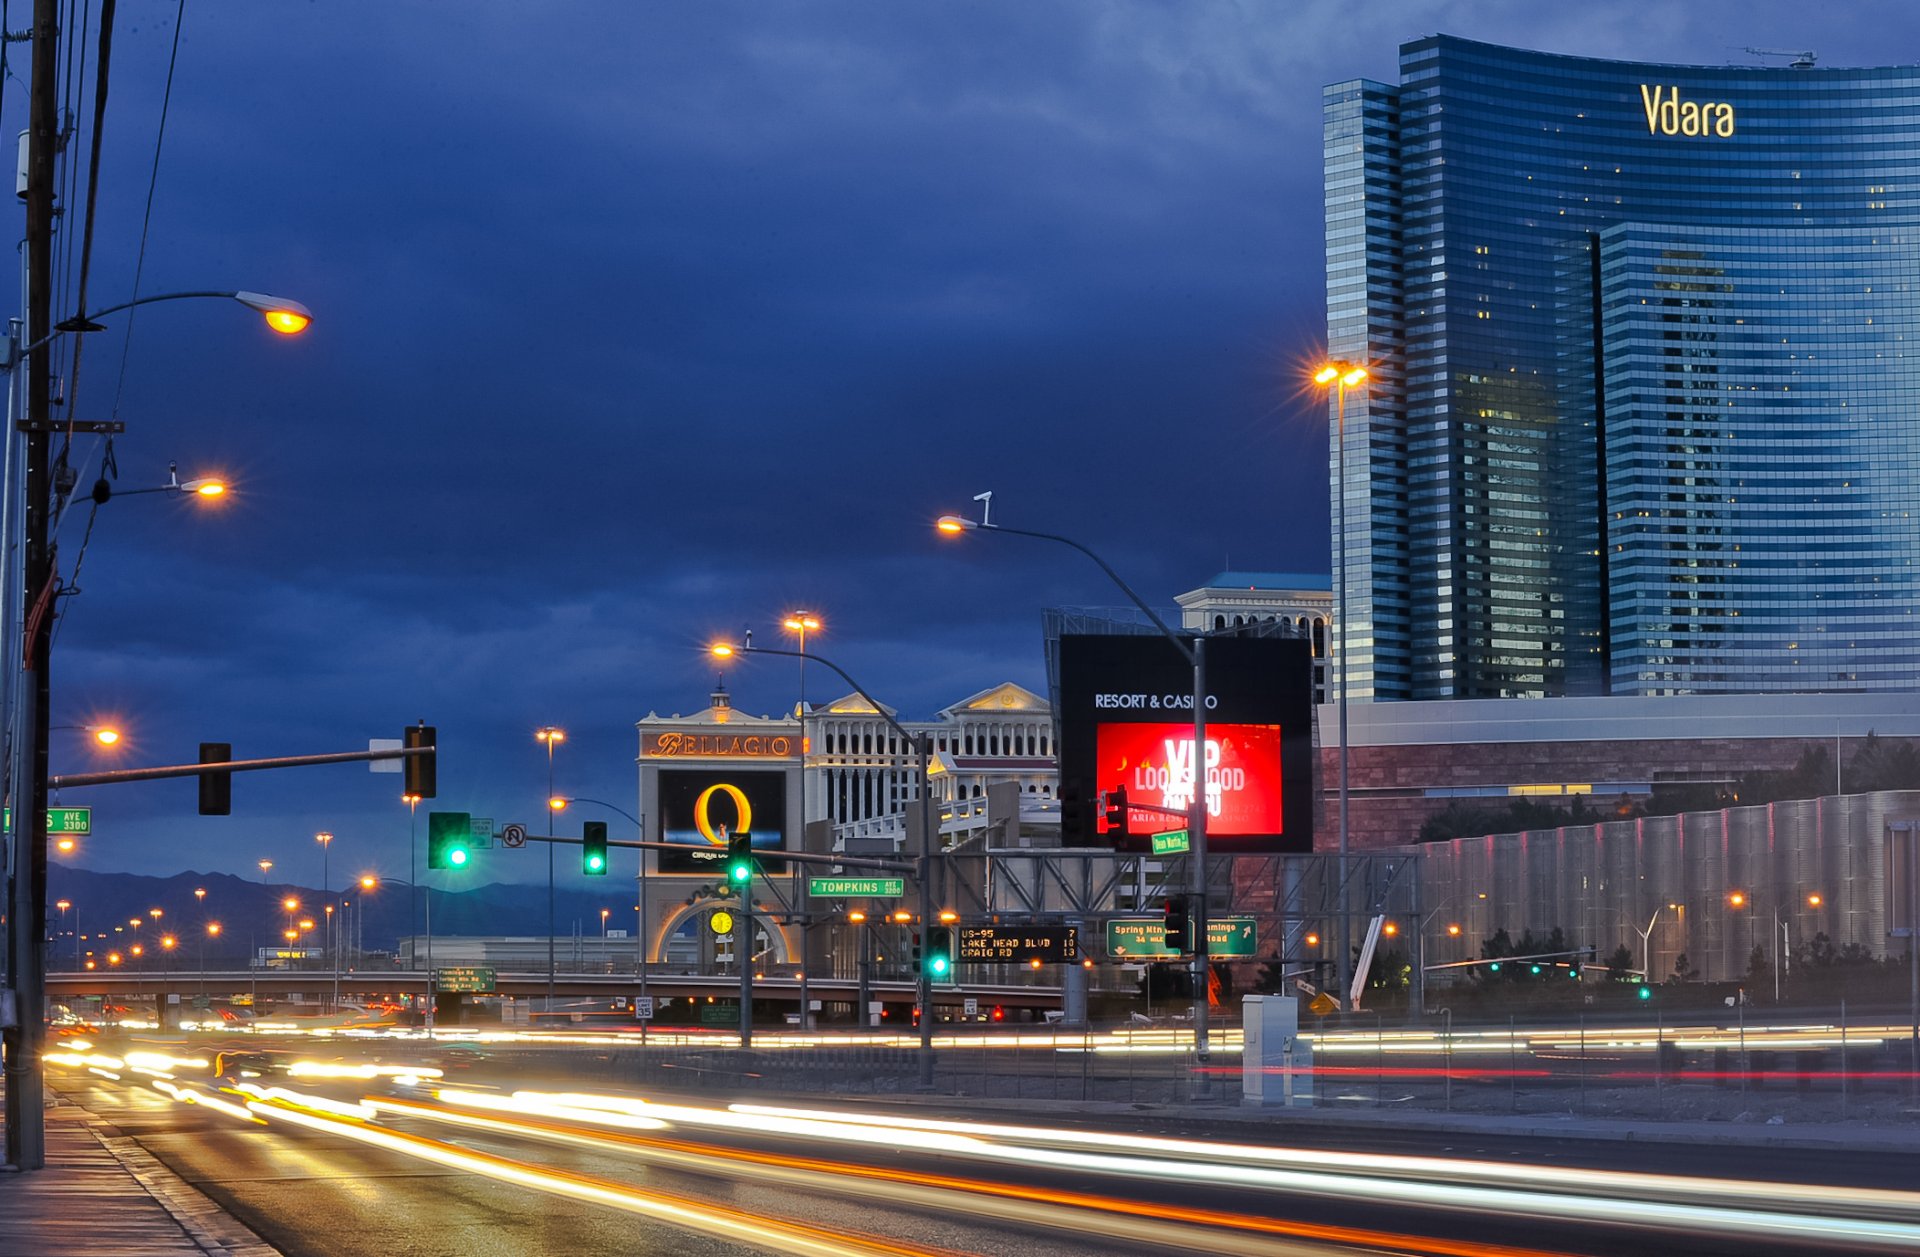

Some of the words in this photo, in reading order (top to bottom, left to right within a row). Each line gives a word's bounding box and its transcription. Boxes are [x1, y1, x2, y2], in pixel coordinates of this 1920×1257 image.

[1640, 84, 1734, 137] Vdara
[1095, 694, 1147, 708] RESORT
[1150, 695, 1160, 708] &
[1163, 695, 1218, 709] CASIO
[650, 732, 790, 758] BELLAGIO
[64, 812, 80, 820] AVE
[64, 821, 87, 830] 3300
[821, 882, 878, 892] TOMPKINS
[1115, 926, 1144, 935] Spring
[1207, 924, 1236, 932] amingo
[962, 930, 994, 938] US-95
[1068, 929, 1075, 938] 7
[961, 940, 987, 948] LAKE
[1063, 939, 1074, 948] 10
[961, 948, 994, 957] CRAIG
[999, 948, 1013, 957] RD
[1063, 948, 1075, 957] 13
[638, 1008, 651, 1016] 35
